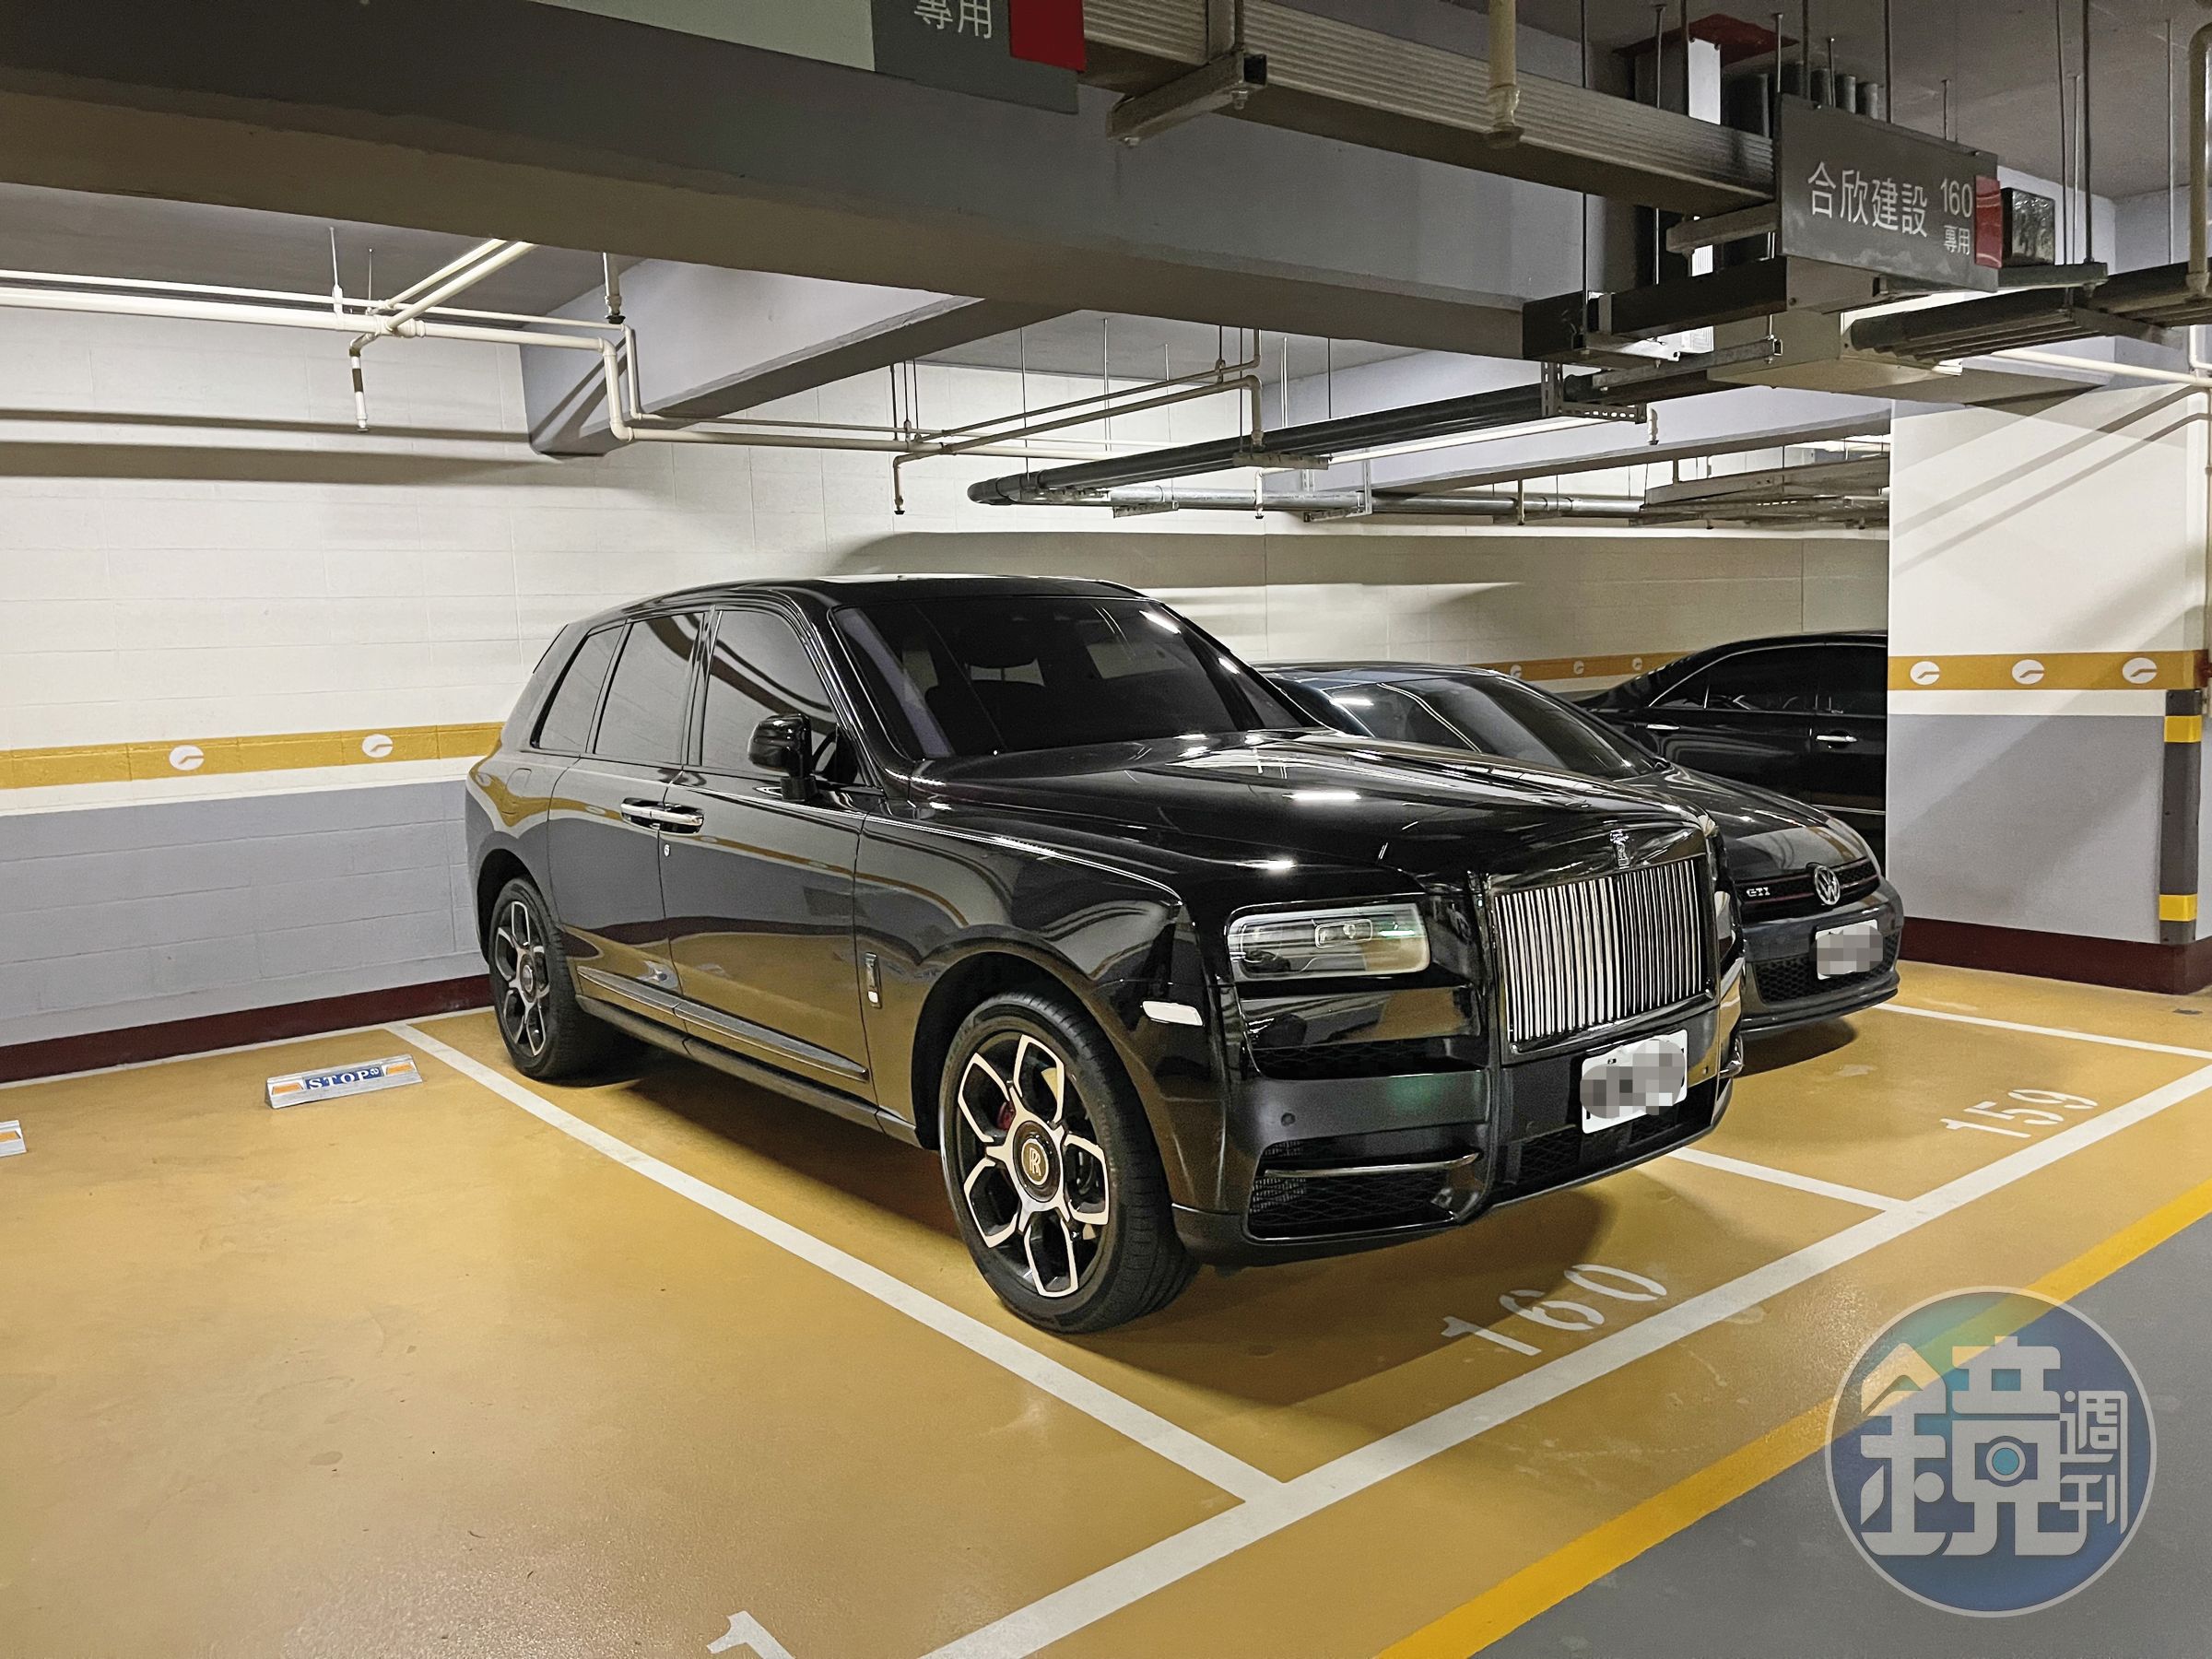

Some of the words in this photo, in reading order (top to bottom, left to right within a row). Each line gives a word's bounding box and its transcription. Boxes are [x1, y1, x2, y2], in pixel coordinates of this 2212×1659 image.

[1807, 161, 1927, 238] 合欣建設
[1940, 178, 1973, 218] 160
[1943, 225, 1971, 255] 專用
[1746, 887, 1771, 898] GTI
[1939, 1088, 2099, 1139] 159
[1441, 1264, 1667, 1357] 160
